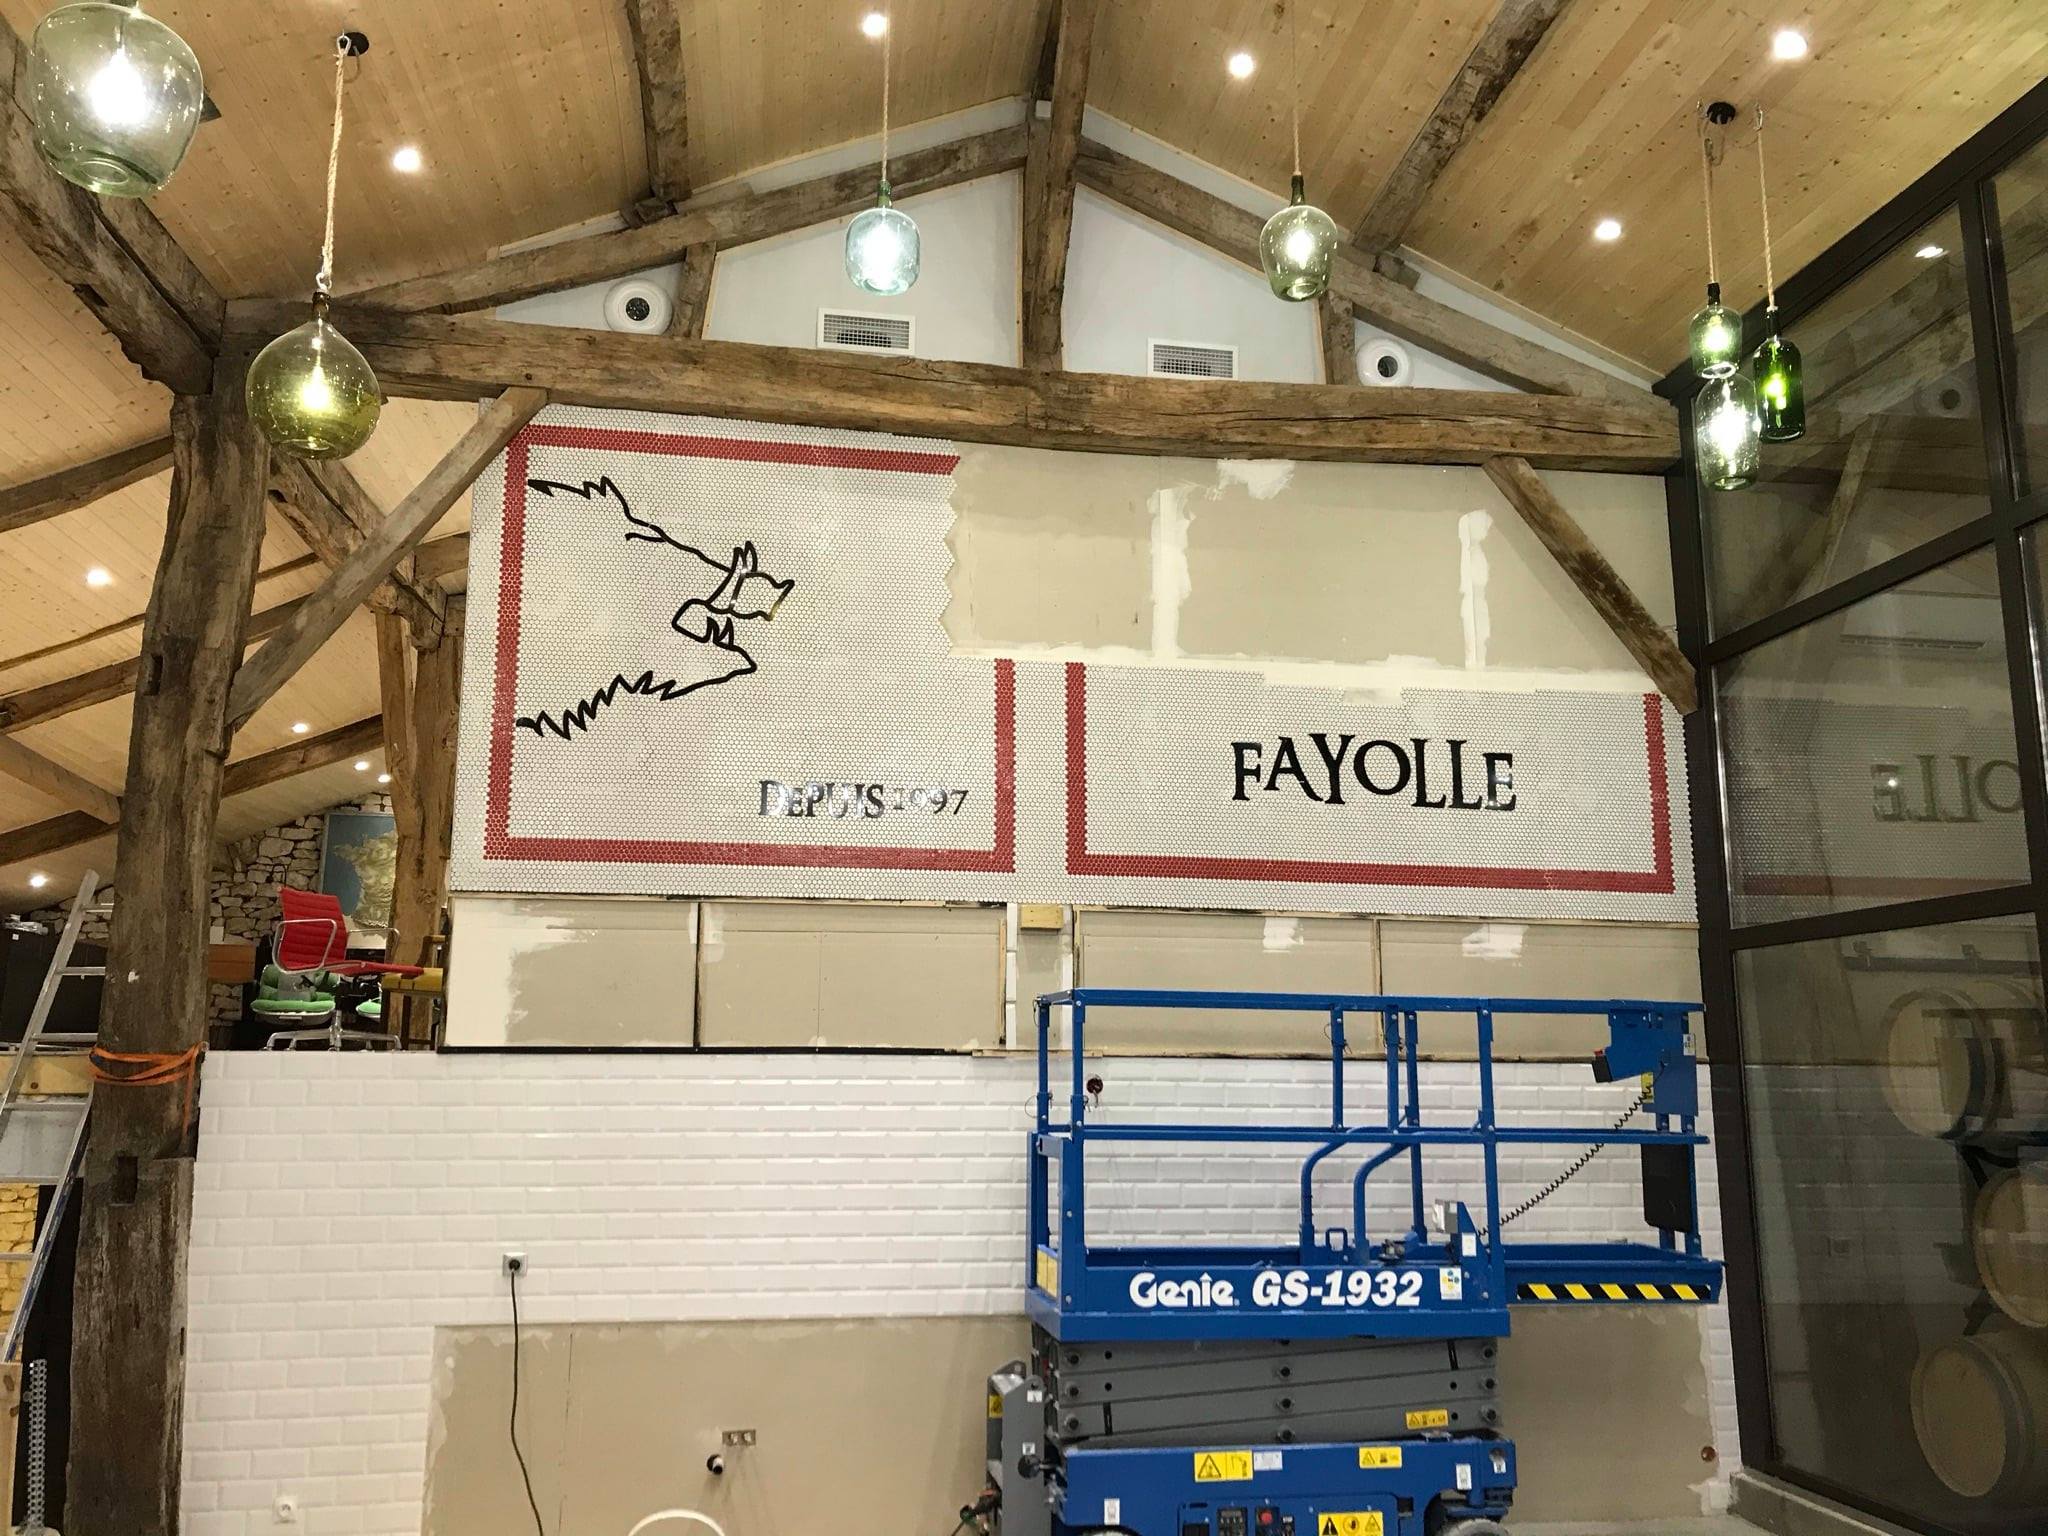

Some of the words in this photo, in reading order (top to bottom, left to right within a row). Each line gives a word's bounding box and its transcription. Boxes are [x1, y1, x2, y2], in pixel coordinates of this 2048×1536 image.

[1230, 733, 1517, 811] FAYOLLE
[758, 780, 885, 819] DEPUIS
[892, 787, 969, 815] 1997
[1129, 1272, 1235, 1307] Genie
[1252, 1270, 1424, 1307] GS-1932
